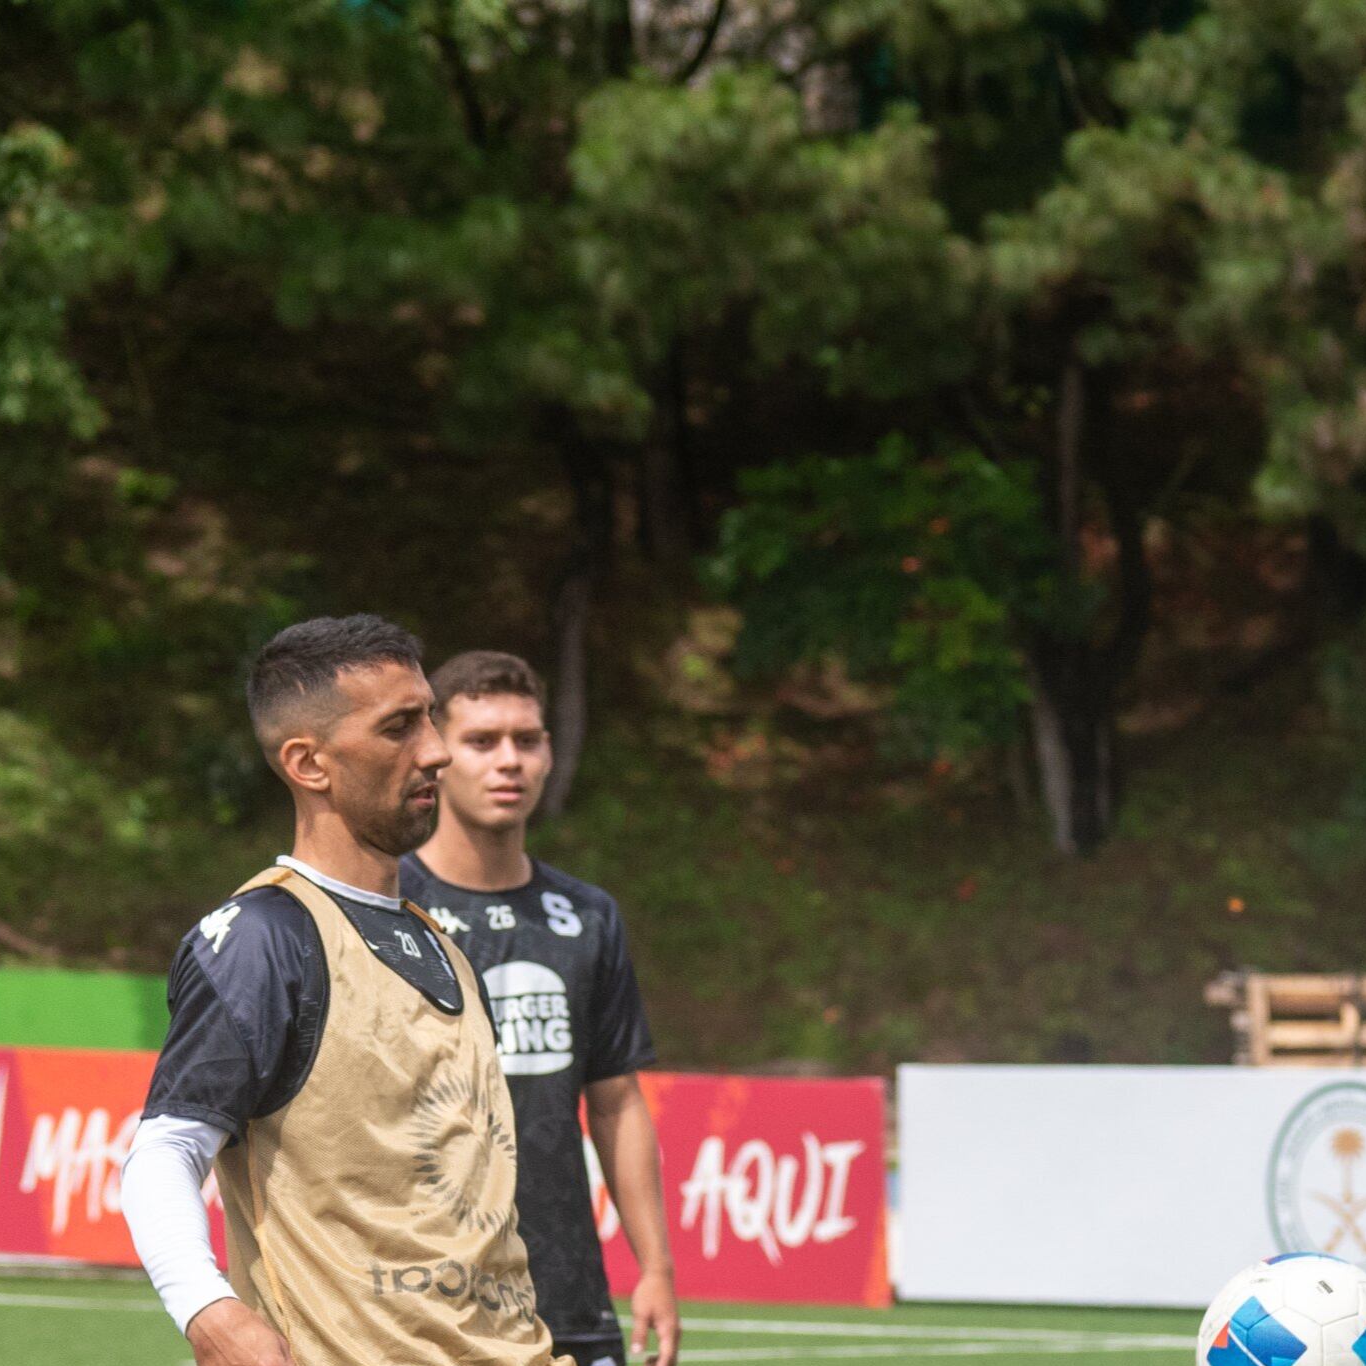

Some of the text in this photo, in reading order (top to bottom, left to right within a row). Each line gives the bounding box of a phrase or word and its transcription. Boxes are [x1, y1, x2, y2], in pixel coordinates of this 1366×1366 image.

[485, 905, 516, 930] 26
[394, 930, 422, 958] 20
[490, 994, 570, 1022] URGER
[496, 1016, 573, 1055] ING
[680, 1131, 866, 1267] AQUI
